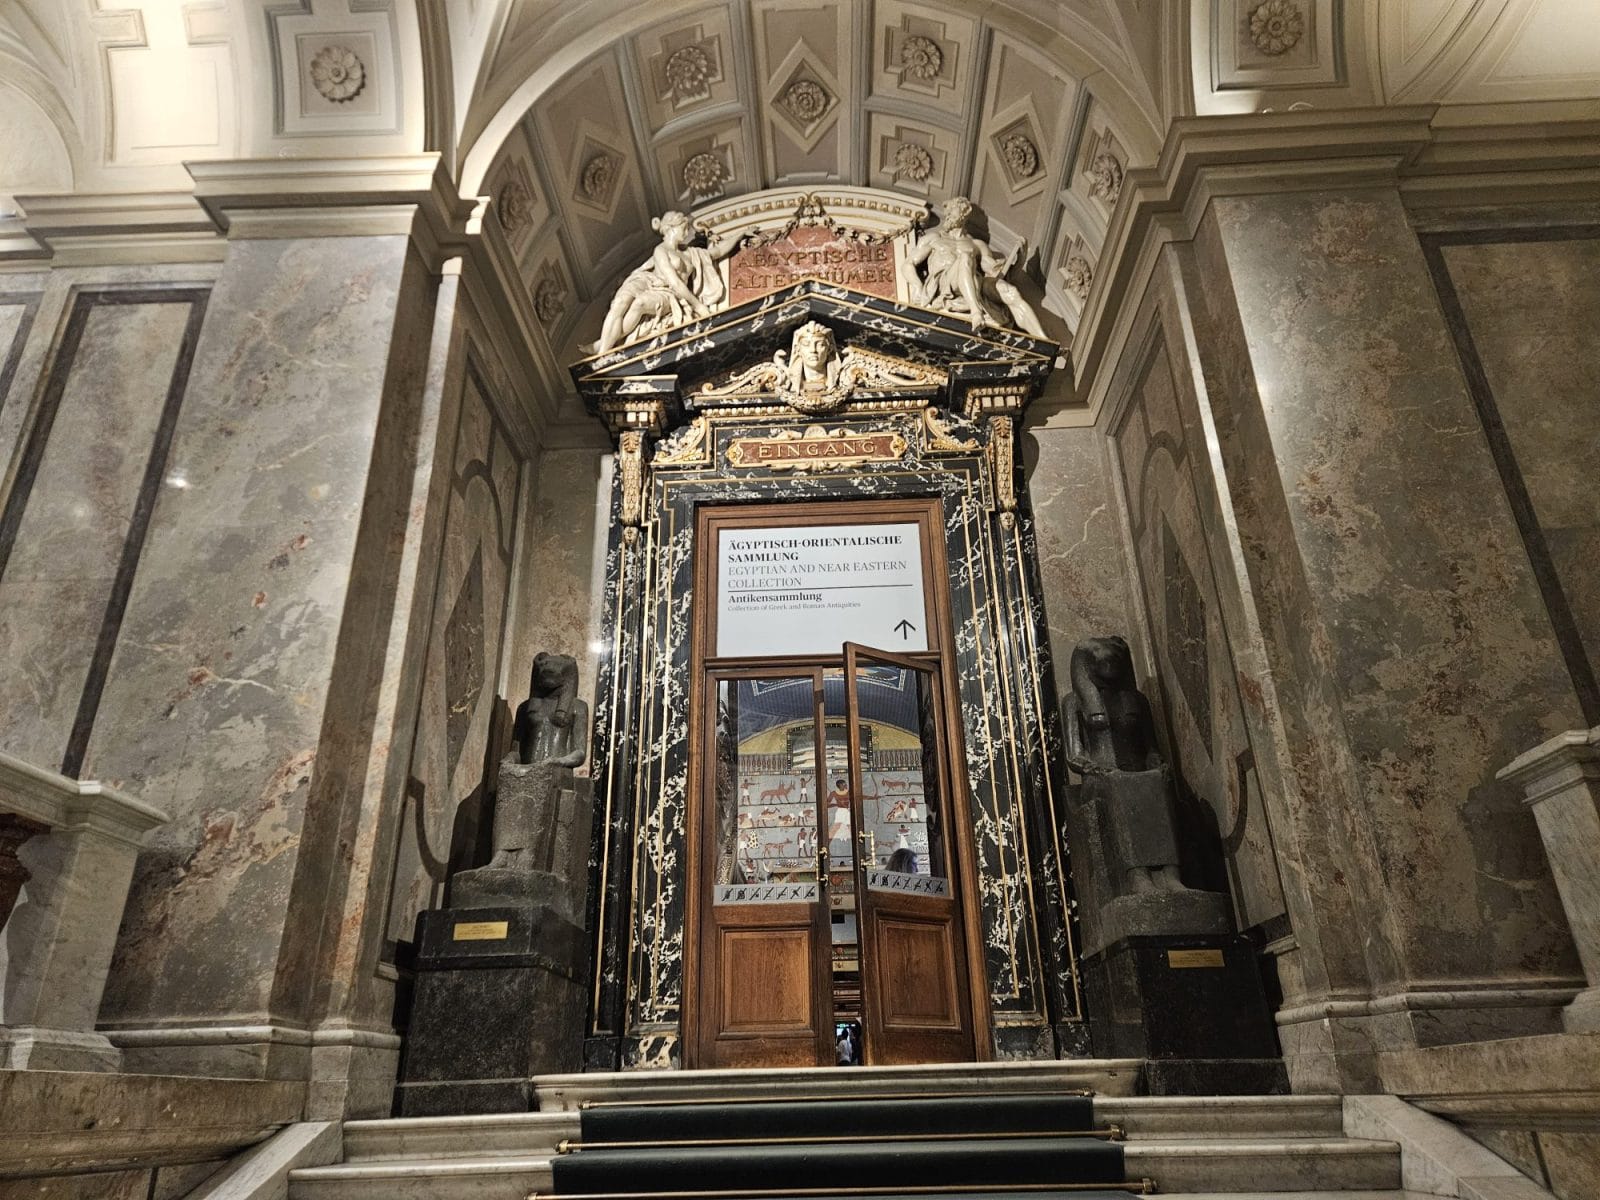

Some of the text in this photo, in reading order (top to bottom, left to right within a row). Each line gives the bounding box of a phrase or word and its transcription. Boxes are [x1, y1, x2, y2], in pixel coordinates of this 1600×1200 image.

[737, 248, 888, 268] AEGYPTISCHE
[758, 441, 876, 458] EINGANG
[729, 535, 902, 550] ÄGYPTISCH-ORIENTALISCHE
[728, 552, 799, 563] SAMMLUNG
[728, 560, 907, 576] EGYPTIAN AND NEAR EASTERN
[728, 577, 802, 589] COLLECTION
[728, 592, 822, 603] Antikensammlung
